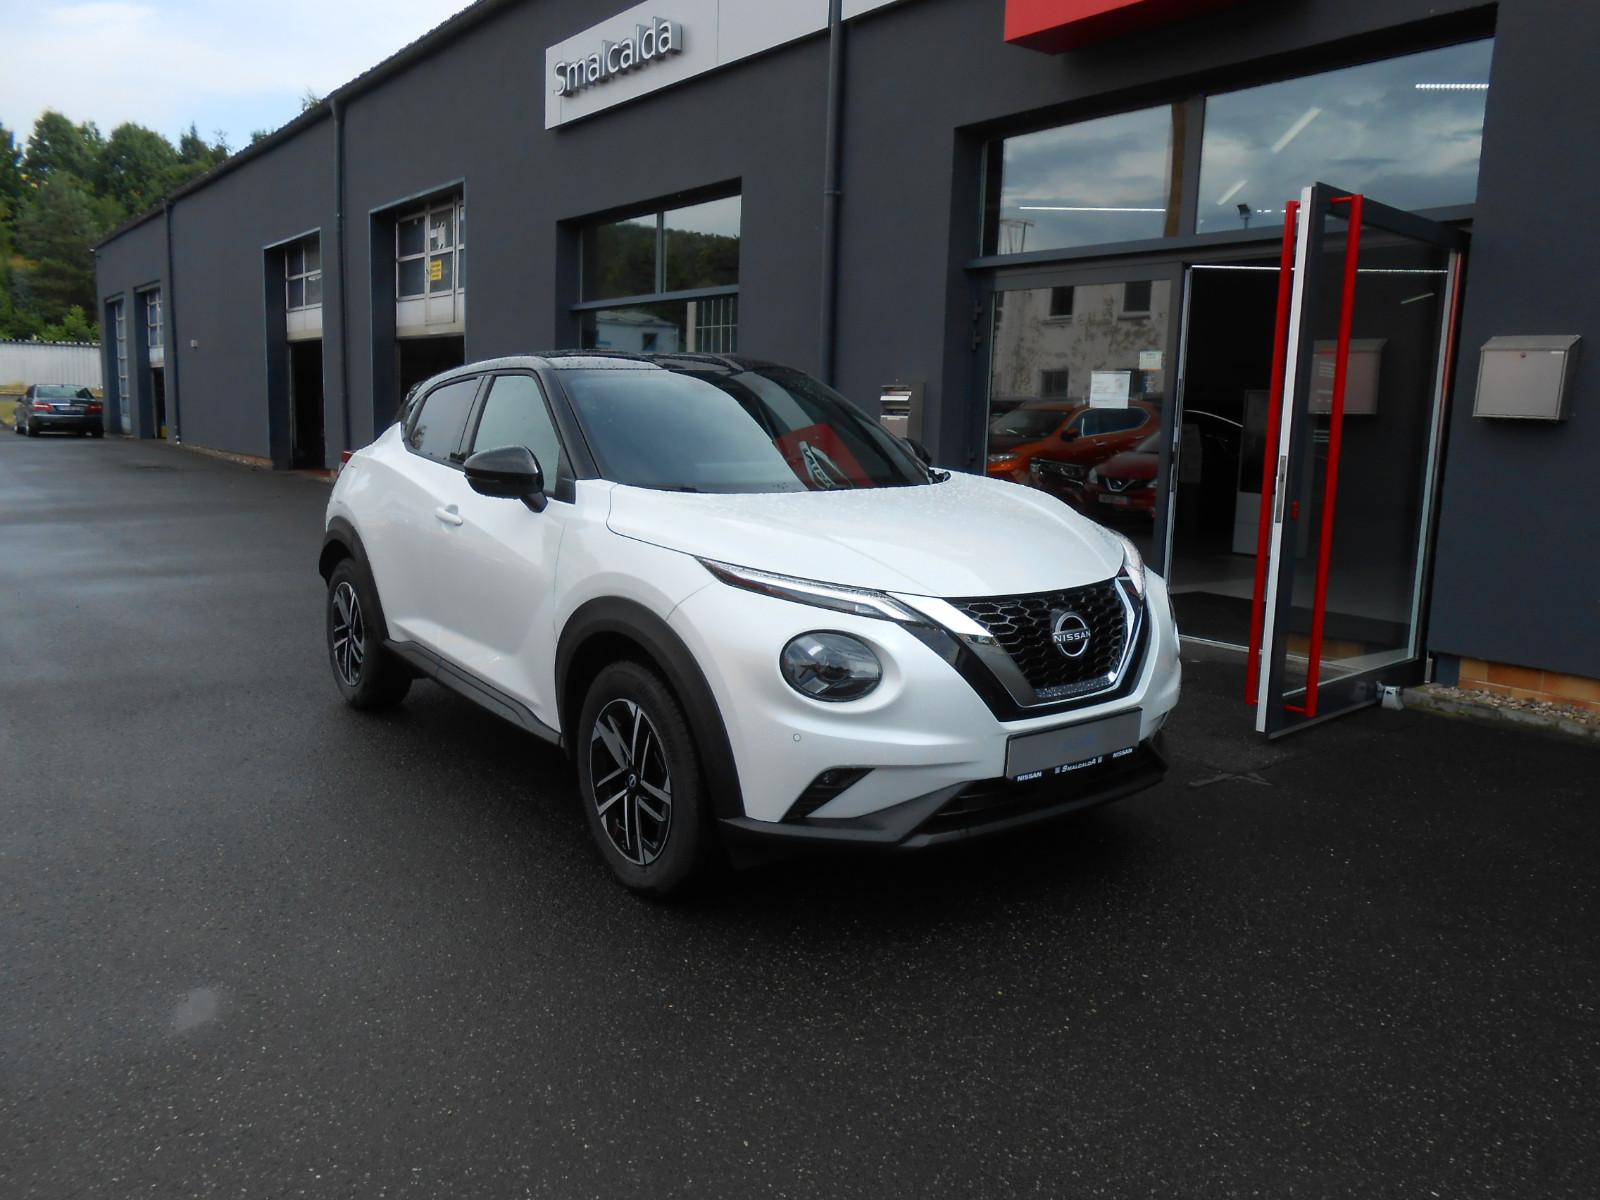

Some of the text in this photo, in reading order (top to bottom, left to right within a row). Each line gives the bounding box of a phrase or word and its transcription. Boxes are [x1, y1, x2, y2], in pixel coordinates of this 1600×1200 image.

[553, 16, 682, 96] Smalcalda
[1053, 630, 1090, 643] NISSAN
[1017, 771, 1042, 782] NISSAN
[1111, 748, 1133, 758] NISSAN
